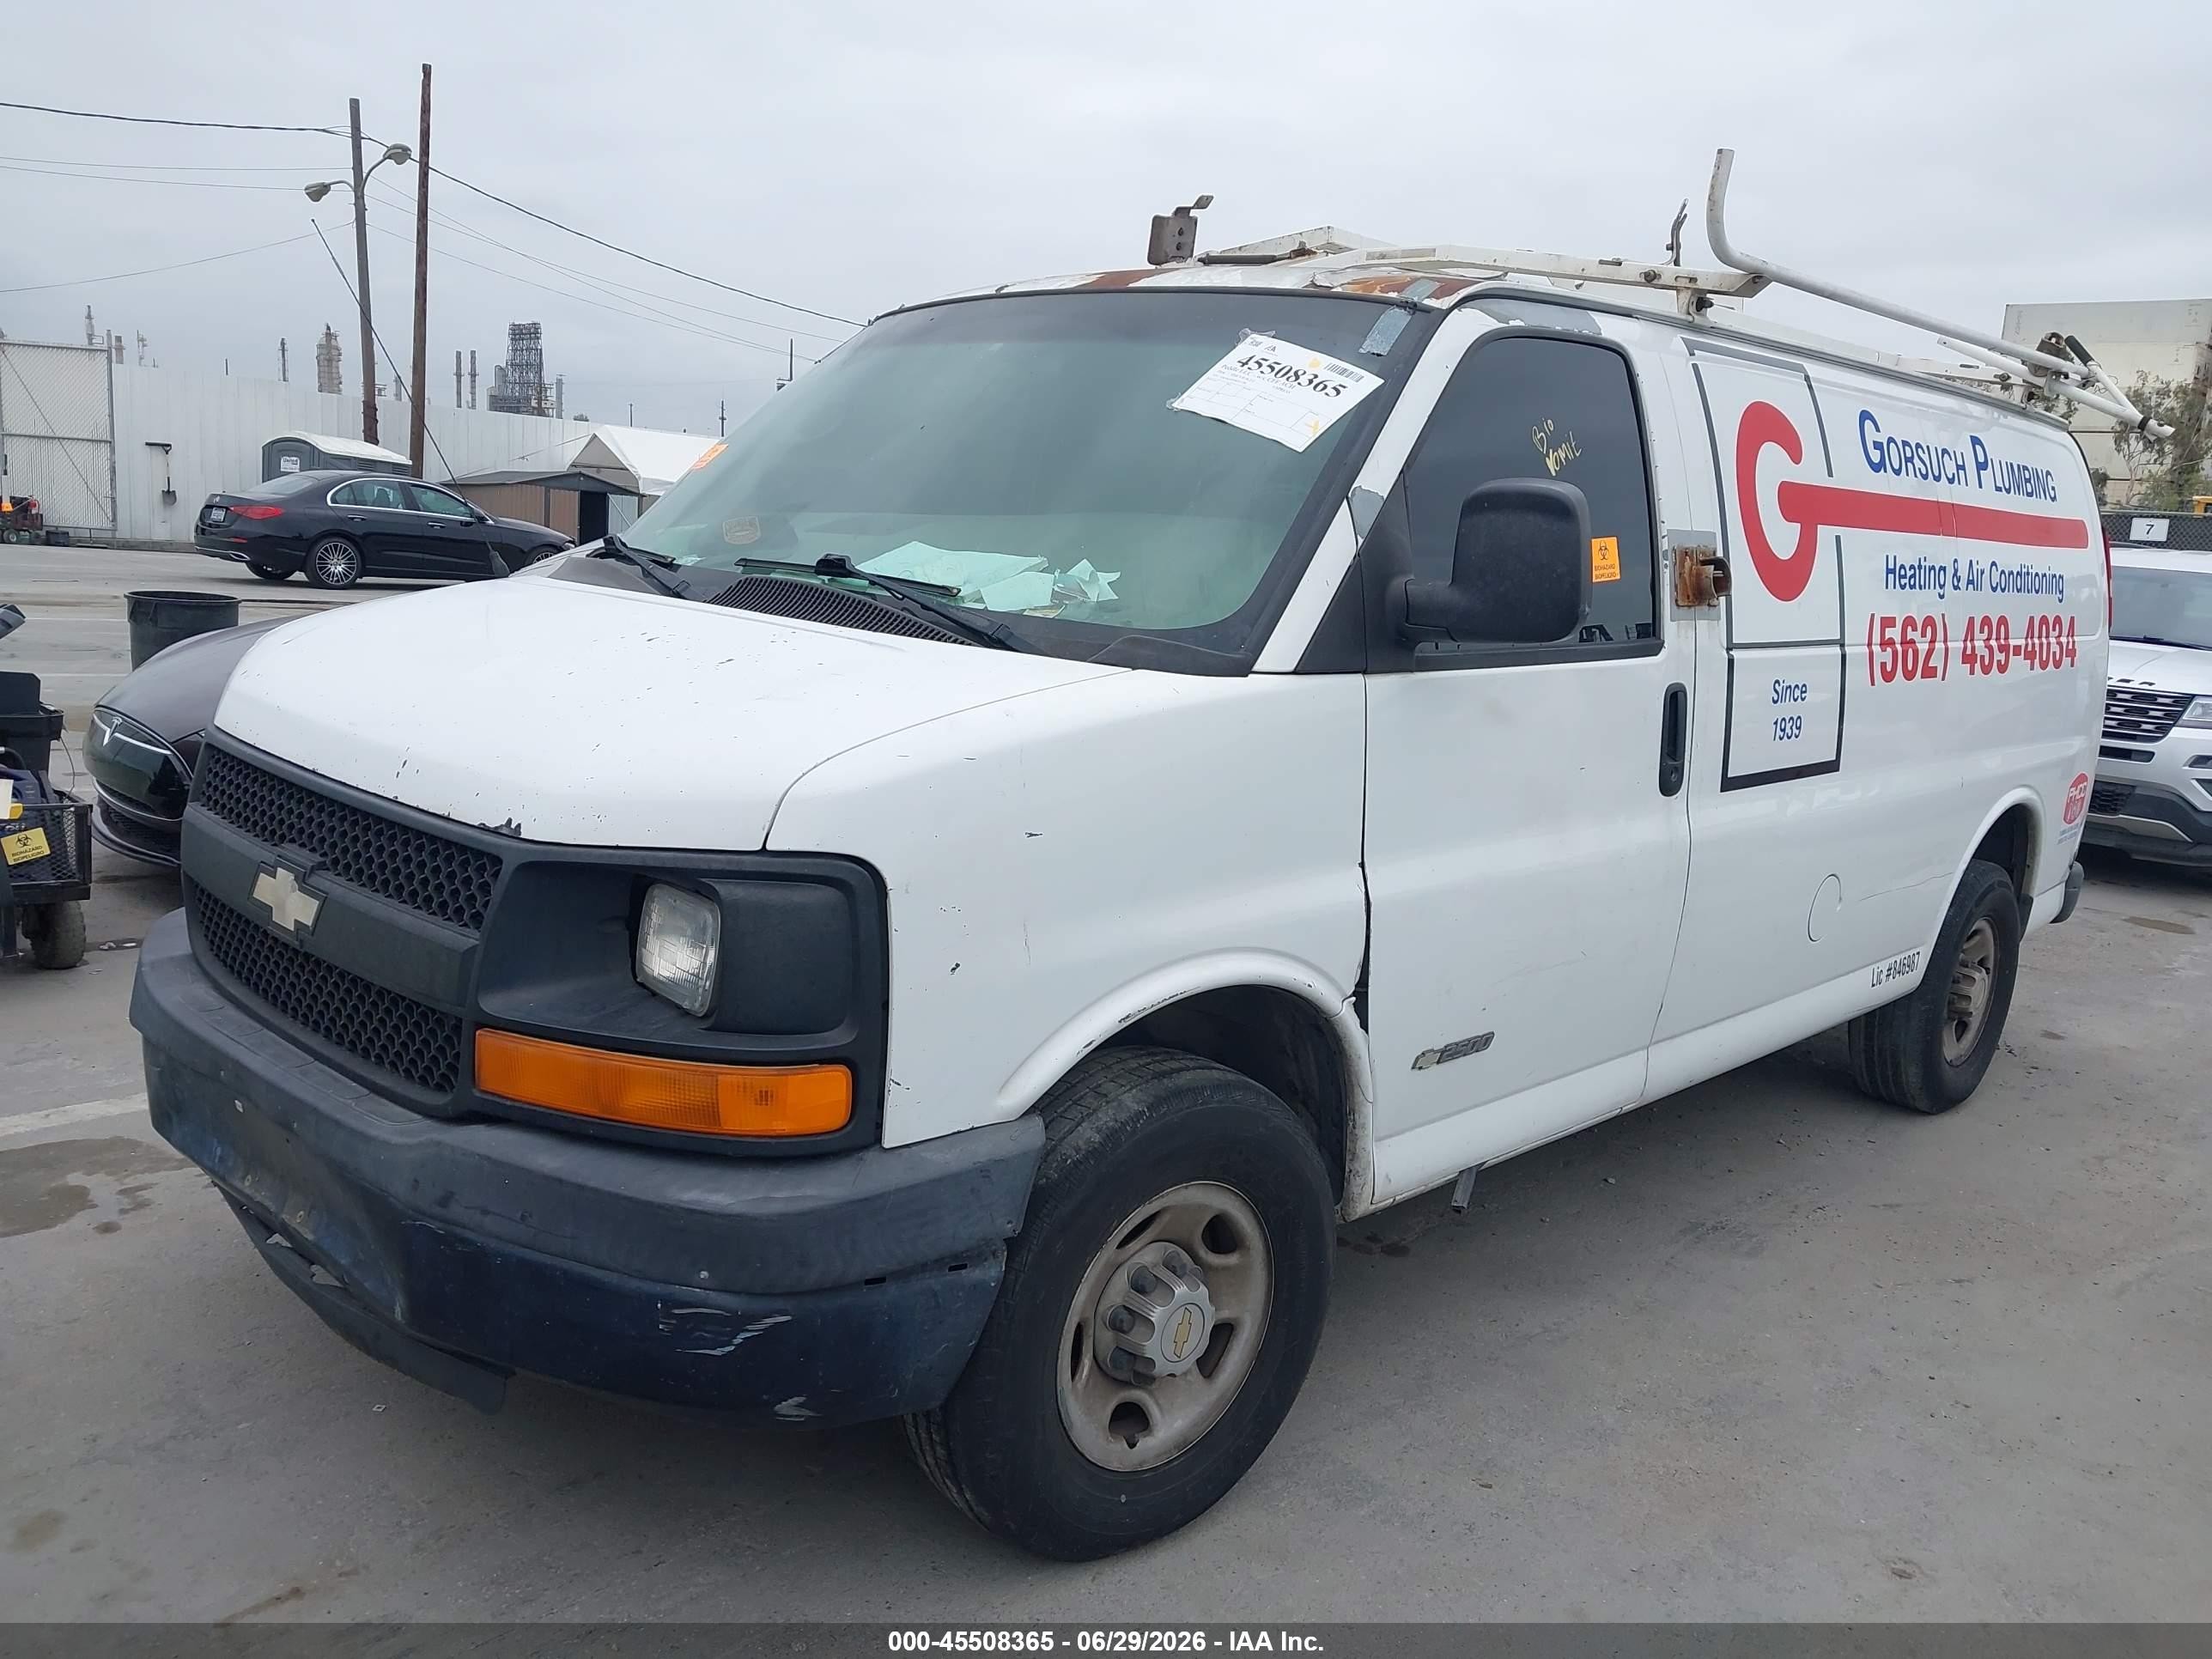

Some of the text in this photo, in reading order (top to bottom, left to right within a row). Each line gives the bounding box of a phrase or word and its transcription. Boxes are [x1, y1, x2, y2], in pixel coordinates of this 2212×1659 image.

[1237, 355, 1348, 398] 45508365
[2146, 524, 2154, 535] 7
[1885, 555, 2064, 603] Heating & Air Conditioning
[1866, 612, 2076, 687] (562) 439-4034
[1771, 678, 1808, 705] Since
[1772, 715, 1802, 741] 1939
[1871, 951, 1921, 988] Lic #846987
